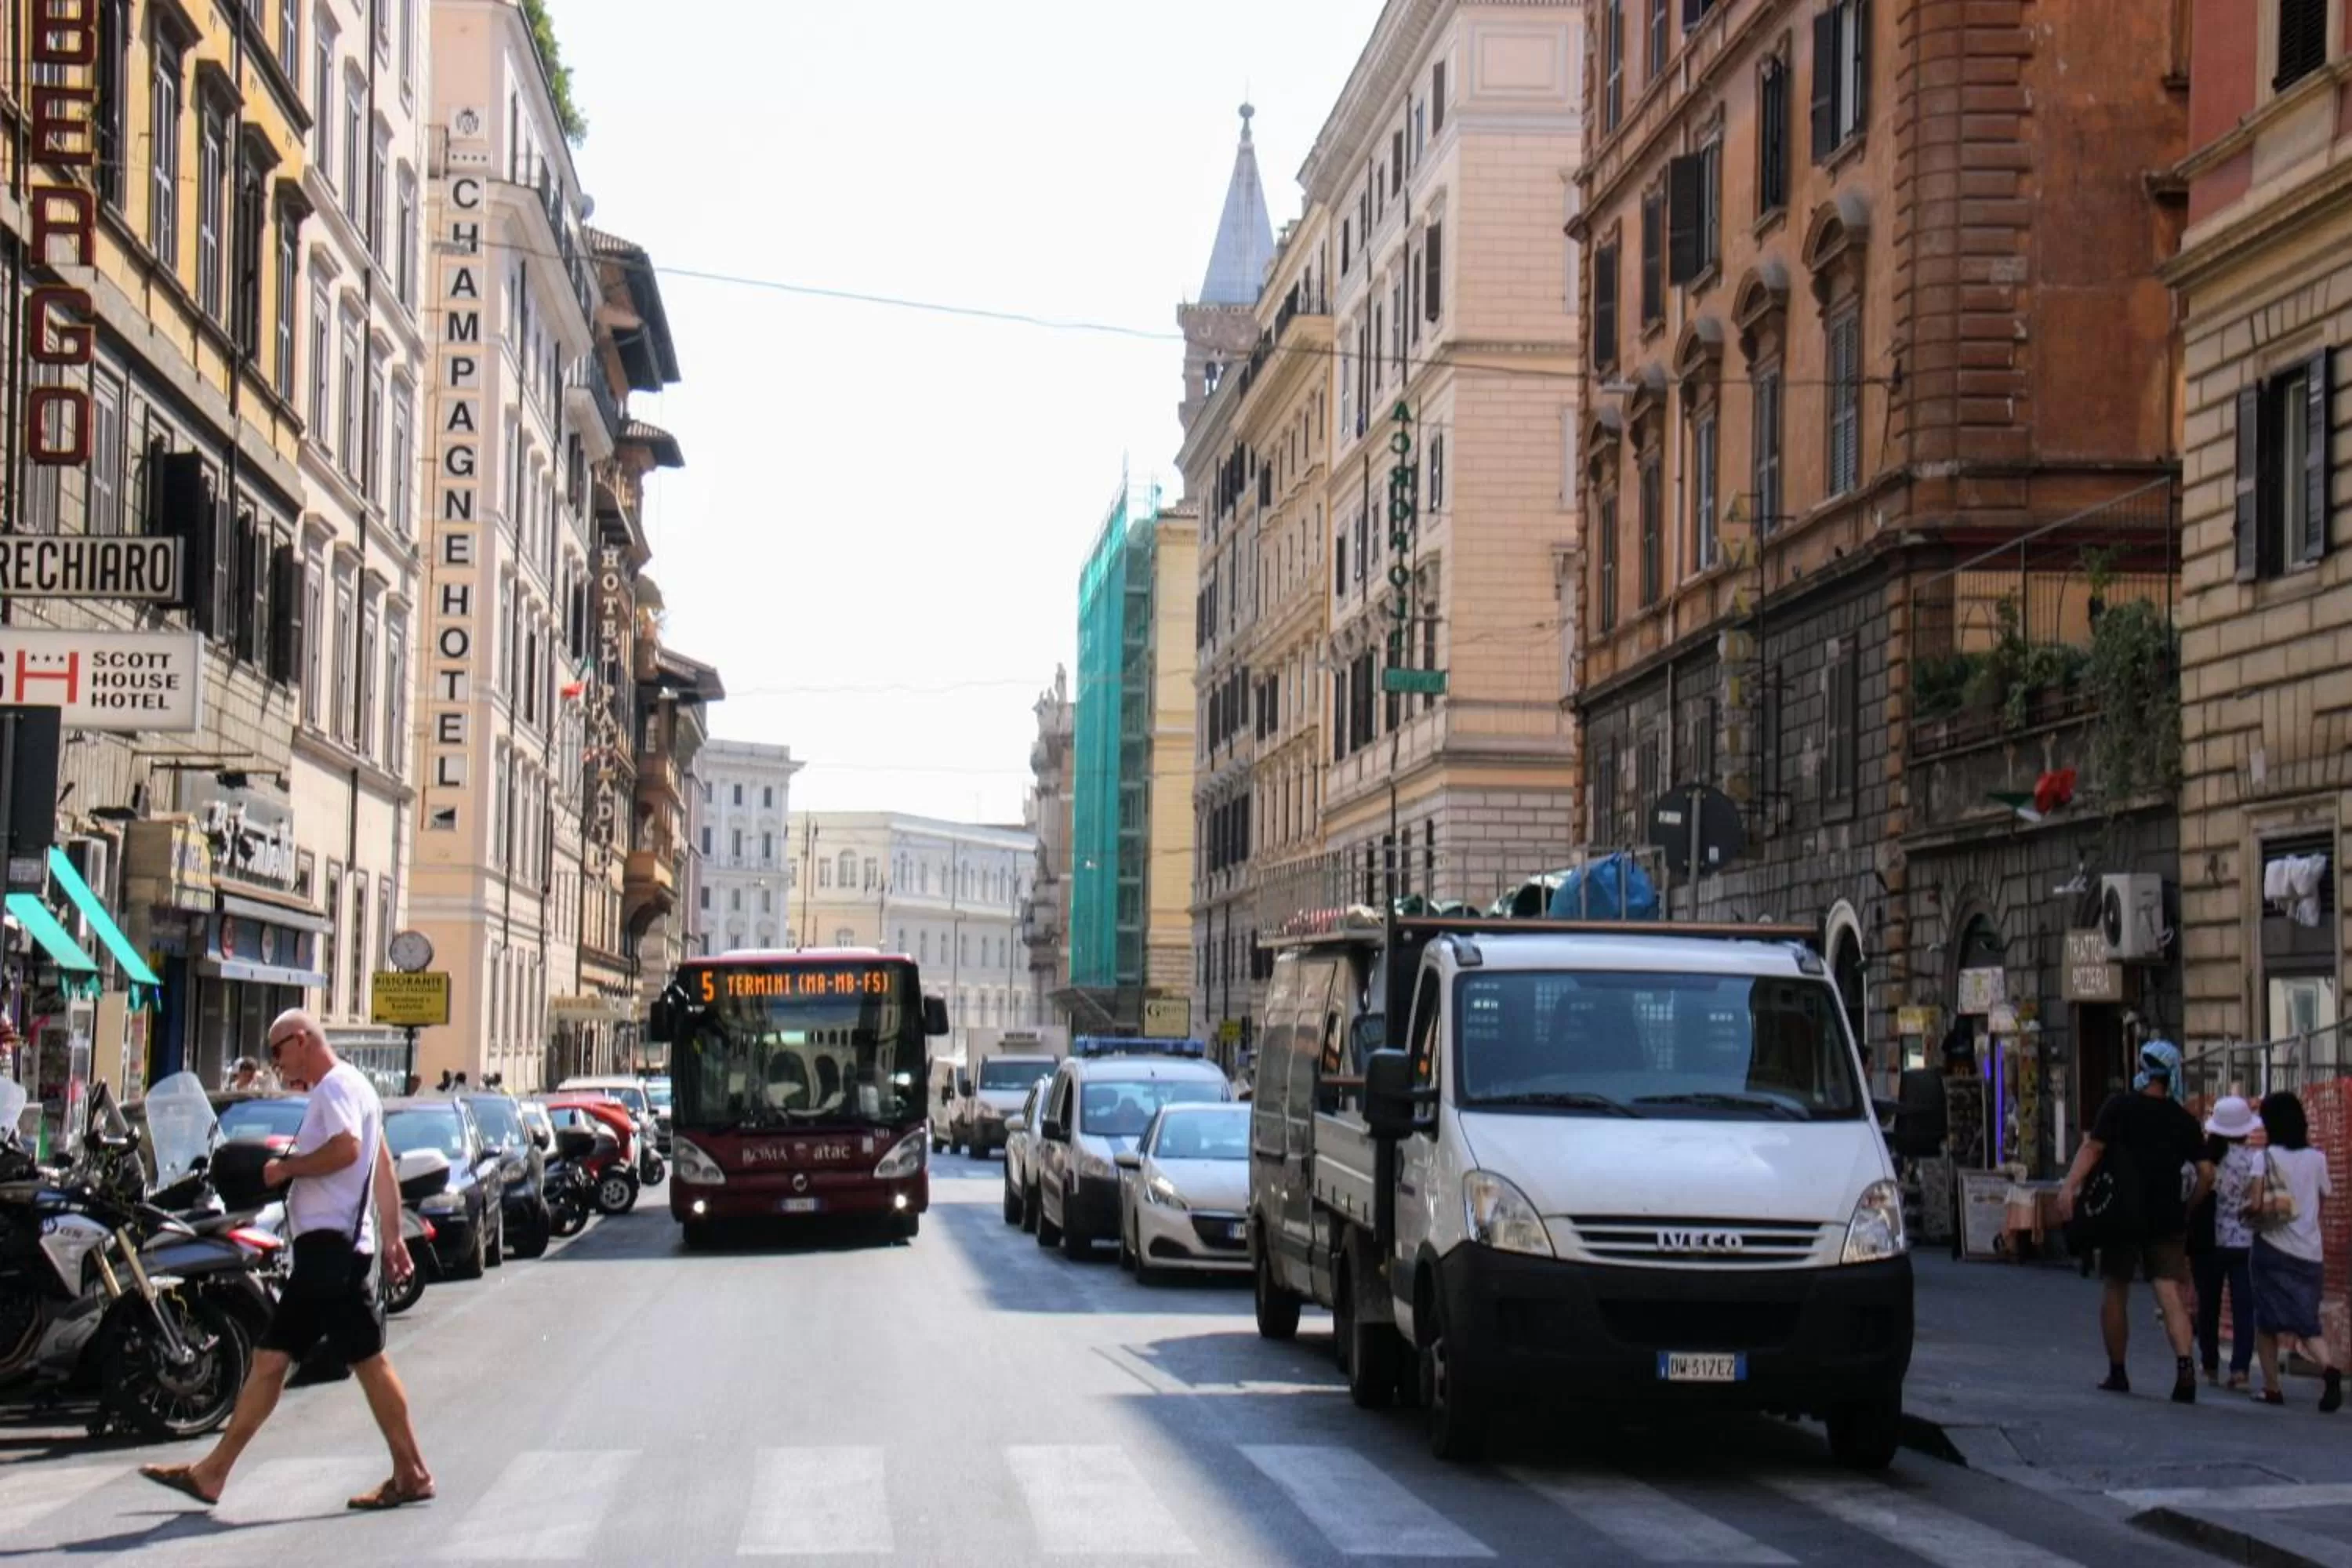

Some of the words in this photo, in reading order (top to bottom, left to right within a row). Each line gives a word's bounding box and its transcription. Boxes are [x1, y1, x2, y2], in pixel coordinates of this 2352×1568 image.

[28, 0, 96, 464] BERGO
[445, 178, 479, 564] CHAMPAGNE
[601, 549, 619, 663] HOTEL
[93, 652, 172, 669] SCOTT
[92, 672, 180, 691] HOUSE
[437, 583, 469, 787] HOTEL
[91, 692, 172, 710] HOTEL
[375, 977, 442, 985] RISTORANTE
[702, 971, 714, 1002] 5
[727, 974, 791, 996] TERMINI
[2073, 967, 2110, 994] PIZZERIA
[742, 1148, 789, 1164] ROMA
[813, 1144, 851, 1160] atac
[1656, 1229, 1744, 1252] IVECO
